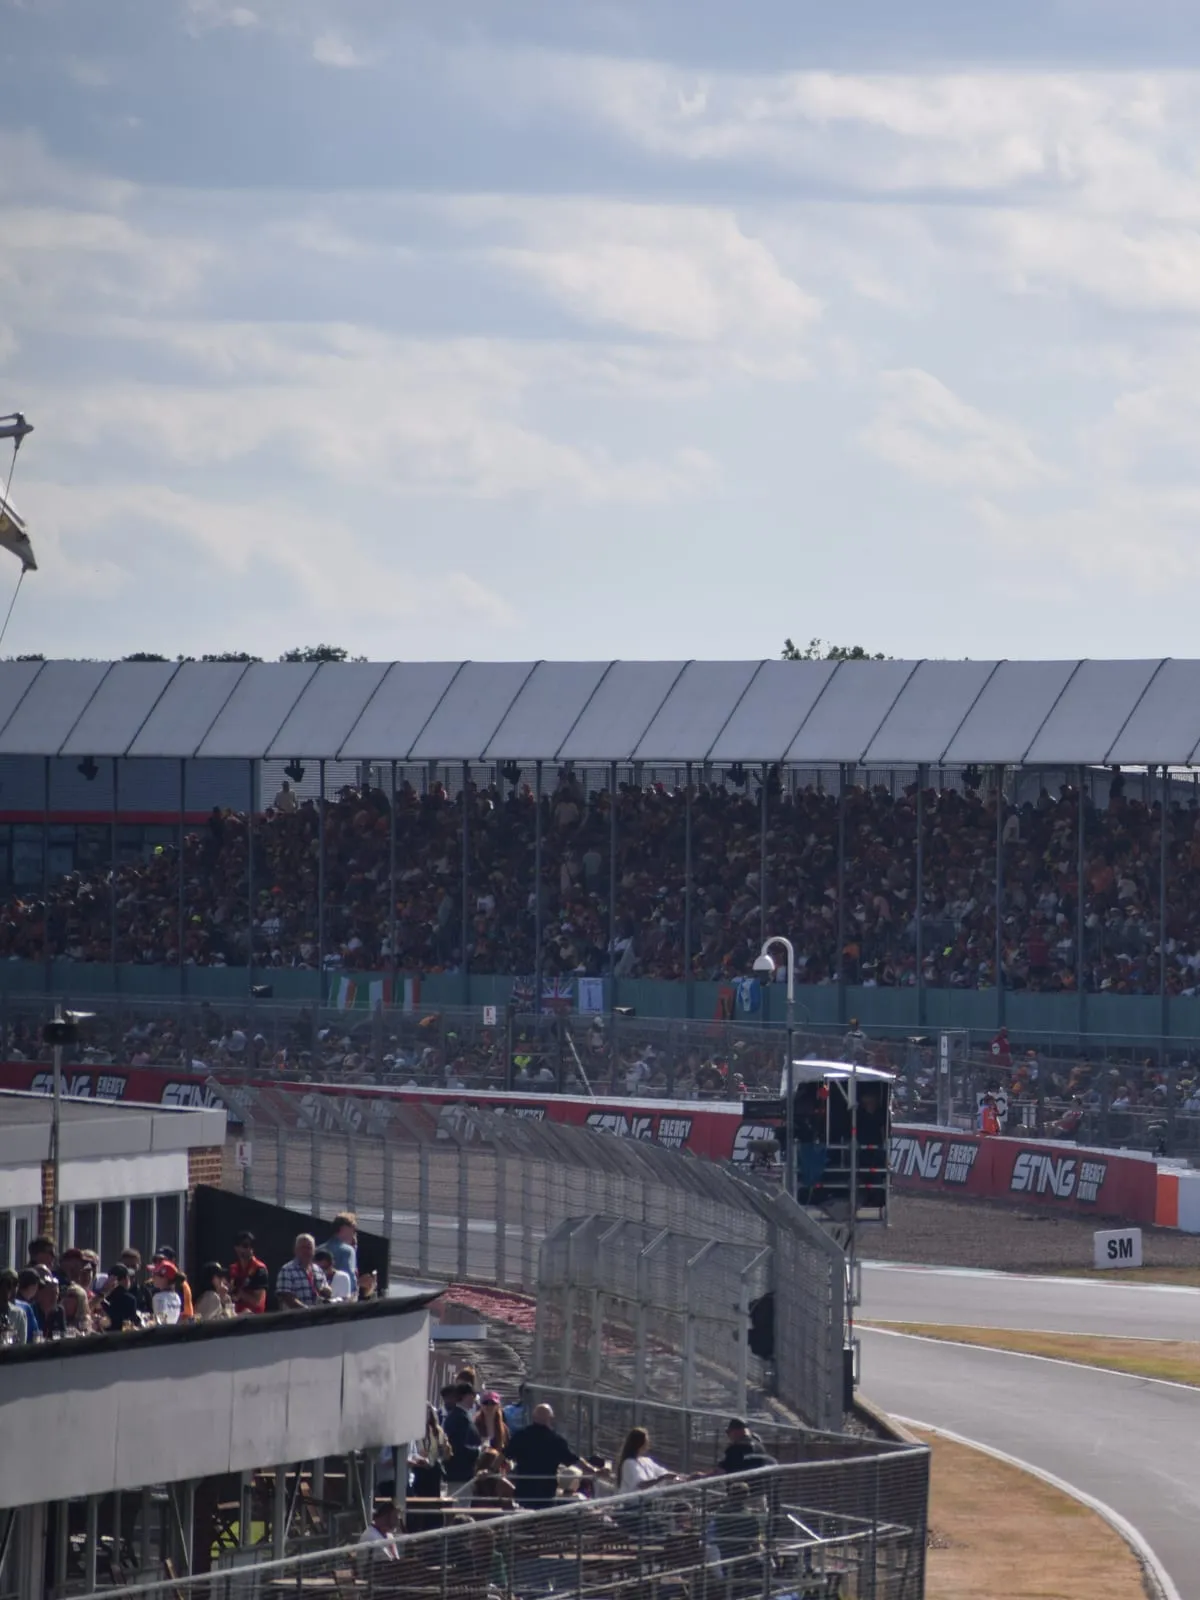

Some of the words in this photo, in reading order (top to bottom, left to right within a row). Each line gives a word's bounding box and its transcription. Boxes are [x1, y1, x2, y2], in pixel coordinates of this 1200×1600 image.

[31, 1074, 91, 1098] STNG
[658, 1119, 692, 1138] ENERGY
[947, 1144, 978, 1165] ENERGY
[1011, 1153, 1077, 1197] STING
[1080, 1162, 1107, 1184] ENERGY
[1107, 1238, 1133, 1260] SM
